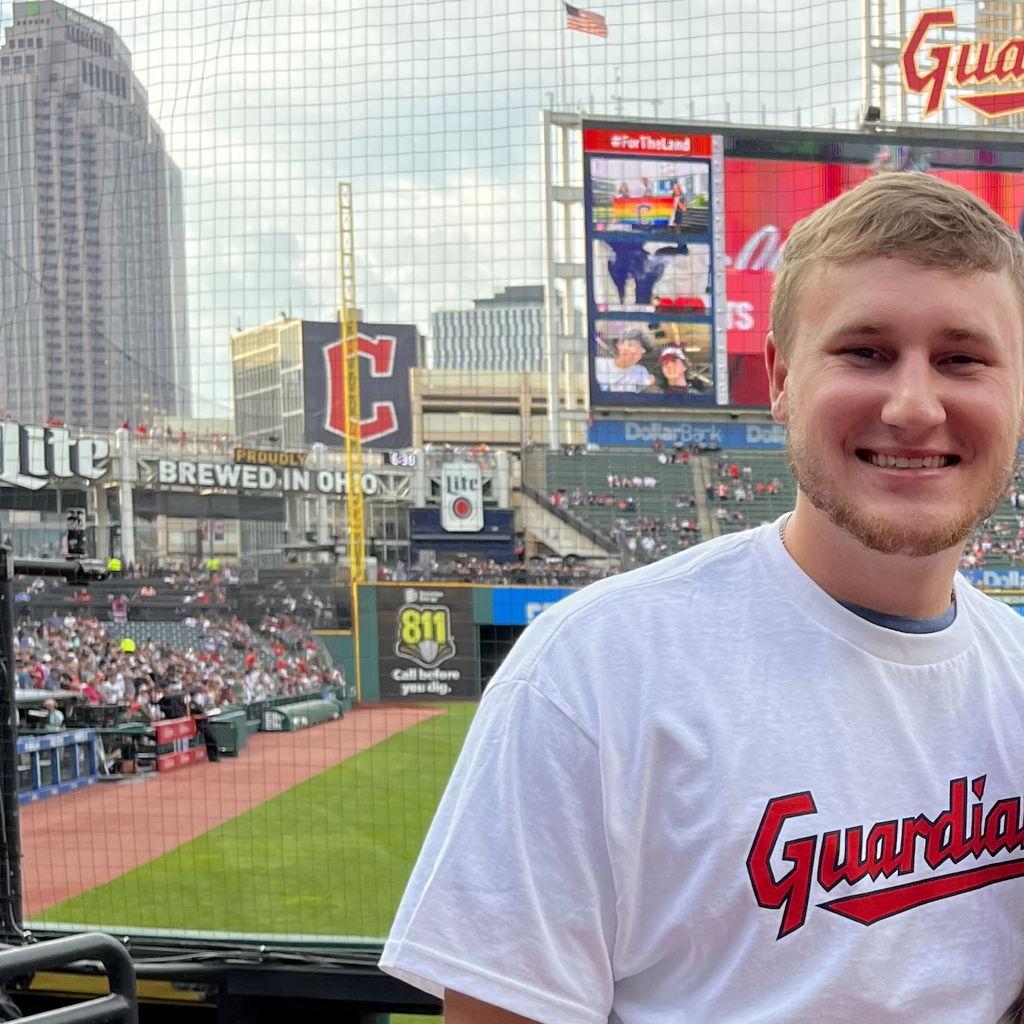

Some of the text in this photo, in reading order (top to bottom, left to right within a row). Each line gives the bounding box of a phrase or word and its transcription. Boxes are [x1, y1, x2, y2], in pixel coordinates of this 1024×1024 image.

[611, 134, 691, 152] #ForTheLand
[322, 332, 399, 443] C
[624, 422, 723, 442] DollarBank
[0, 421, 109, 491] Lite
[236, 450, 308, 466] PROUDLY
[159, 460, 277, 490] BREWED
[283, 467, 310, 491] IN
[446, 475, 479, 496] Lite
[402, 609, 446, 645] 811
[392, 669, 460, 681] Call before
[402, 681, 452, 696] you dig.
